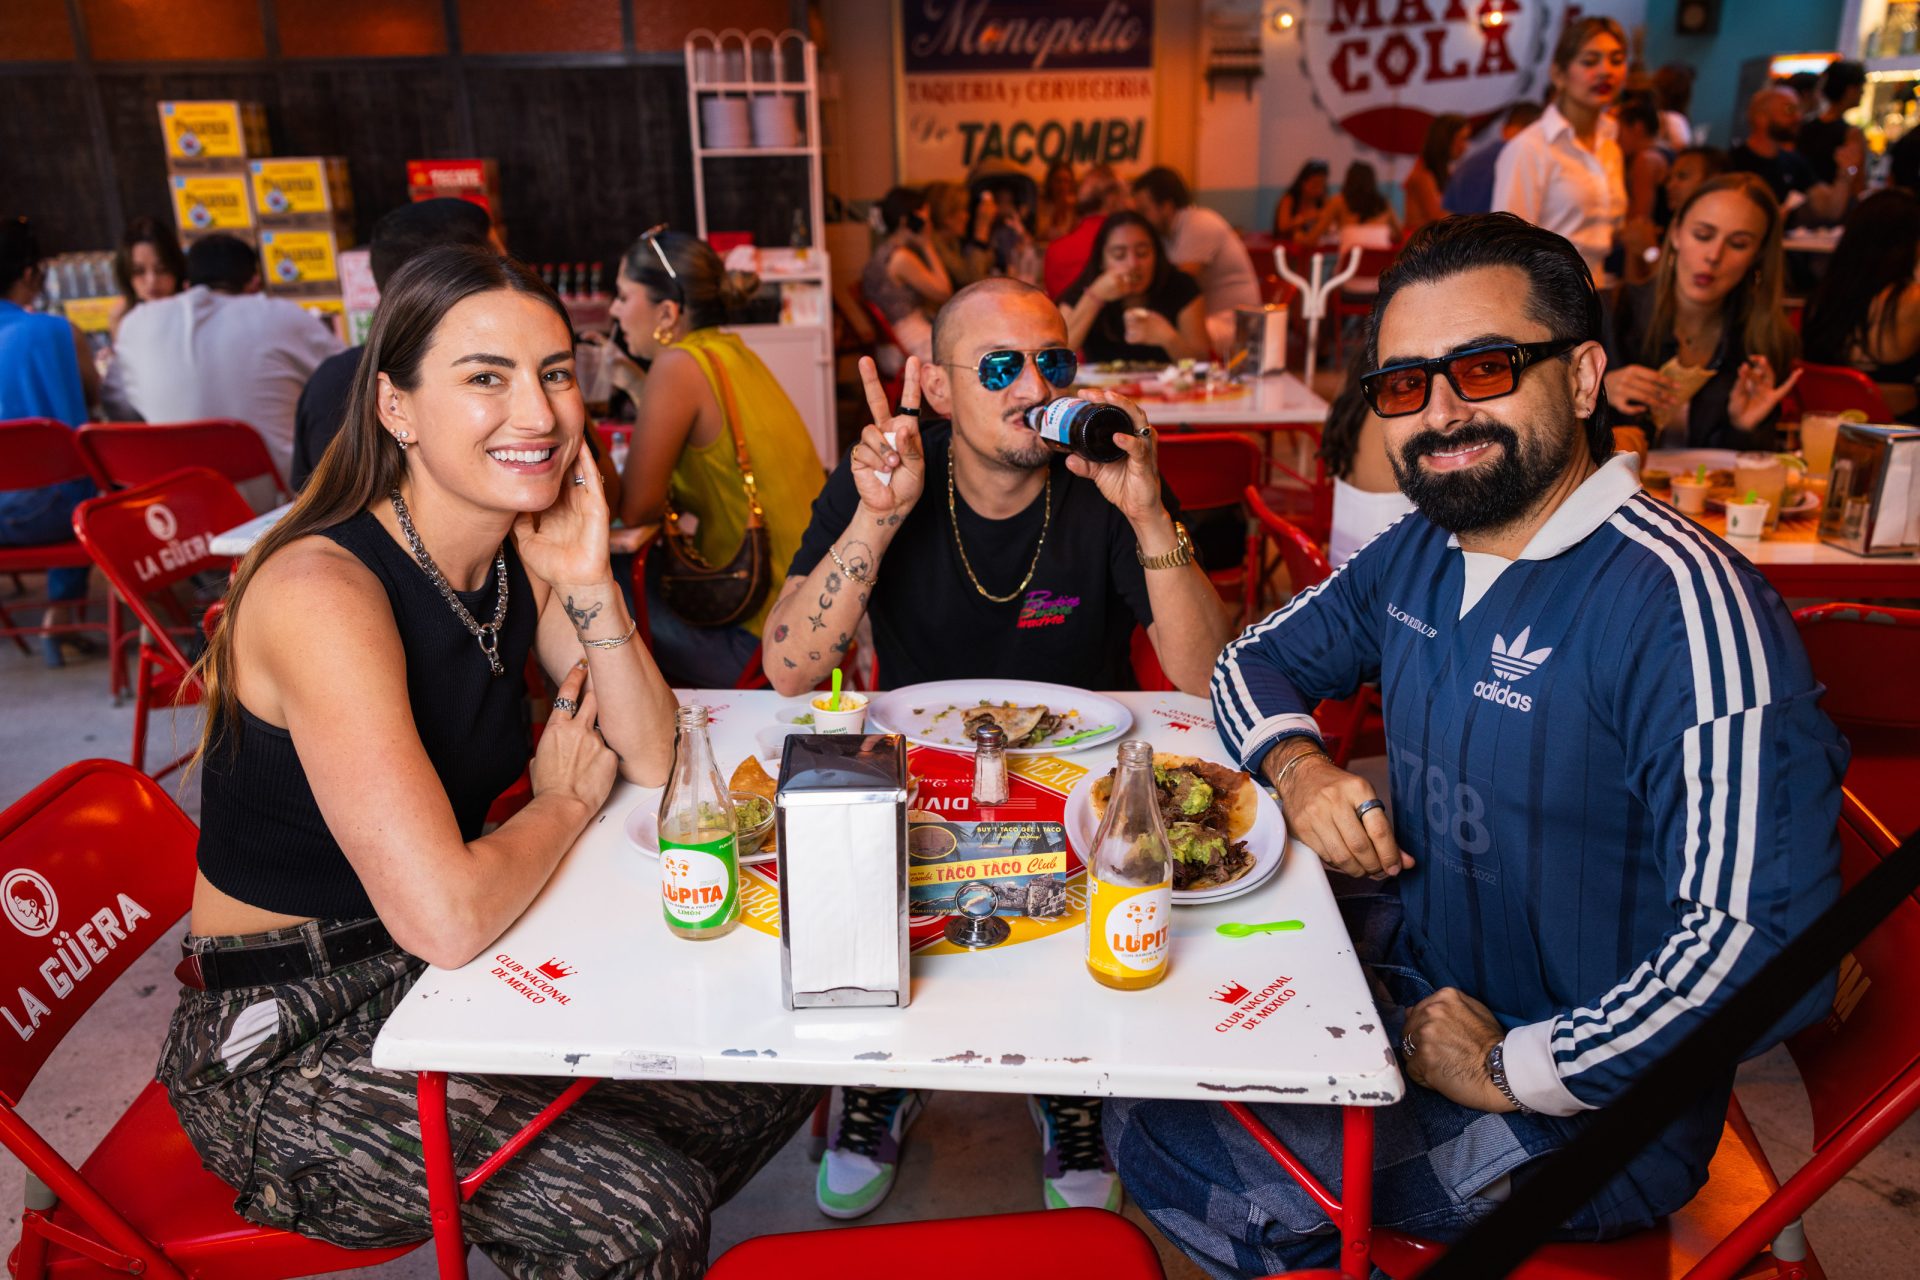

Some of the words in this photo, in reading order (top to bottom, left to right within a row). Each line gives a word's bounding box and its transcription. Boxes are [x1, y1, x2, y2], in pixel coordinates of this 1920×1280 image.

[911, 0, 1142, 70] Monopolio
[1330, 20, 1517, 94] COLA
[958, 118, 1145, 166] TACOMBI
[133, 555, 162, 581] LA
[1473, 681, 1532, 712] adidas
[936, 864, 976, 881] TACO
[983, 861, 1022, 877] TACO
[1027, 856, 1057, 874] Club
[662, 880, 723, 905] LUPITA
[0, 987, 51, 1041] LA
[39, 893, 151, 999] GÜERA
[490, 967, 507, 980] DE
[505, 977, 546, 1004] MEXICO
[495, 953, 523, 973] CLUB
[519, 970, 572, 1006] NACIONAL
[1215, 1011, 1245, 1032] CLUB
[1240, 976, 1293, 1013] NACIONAL
[1241, 1017, 1262, 1030] DE
[1256, 989, 1296, 1019] MEXICO
